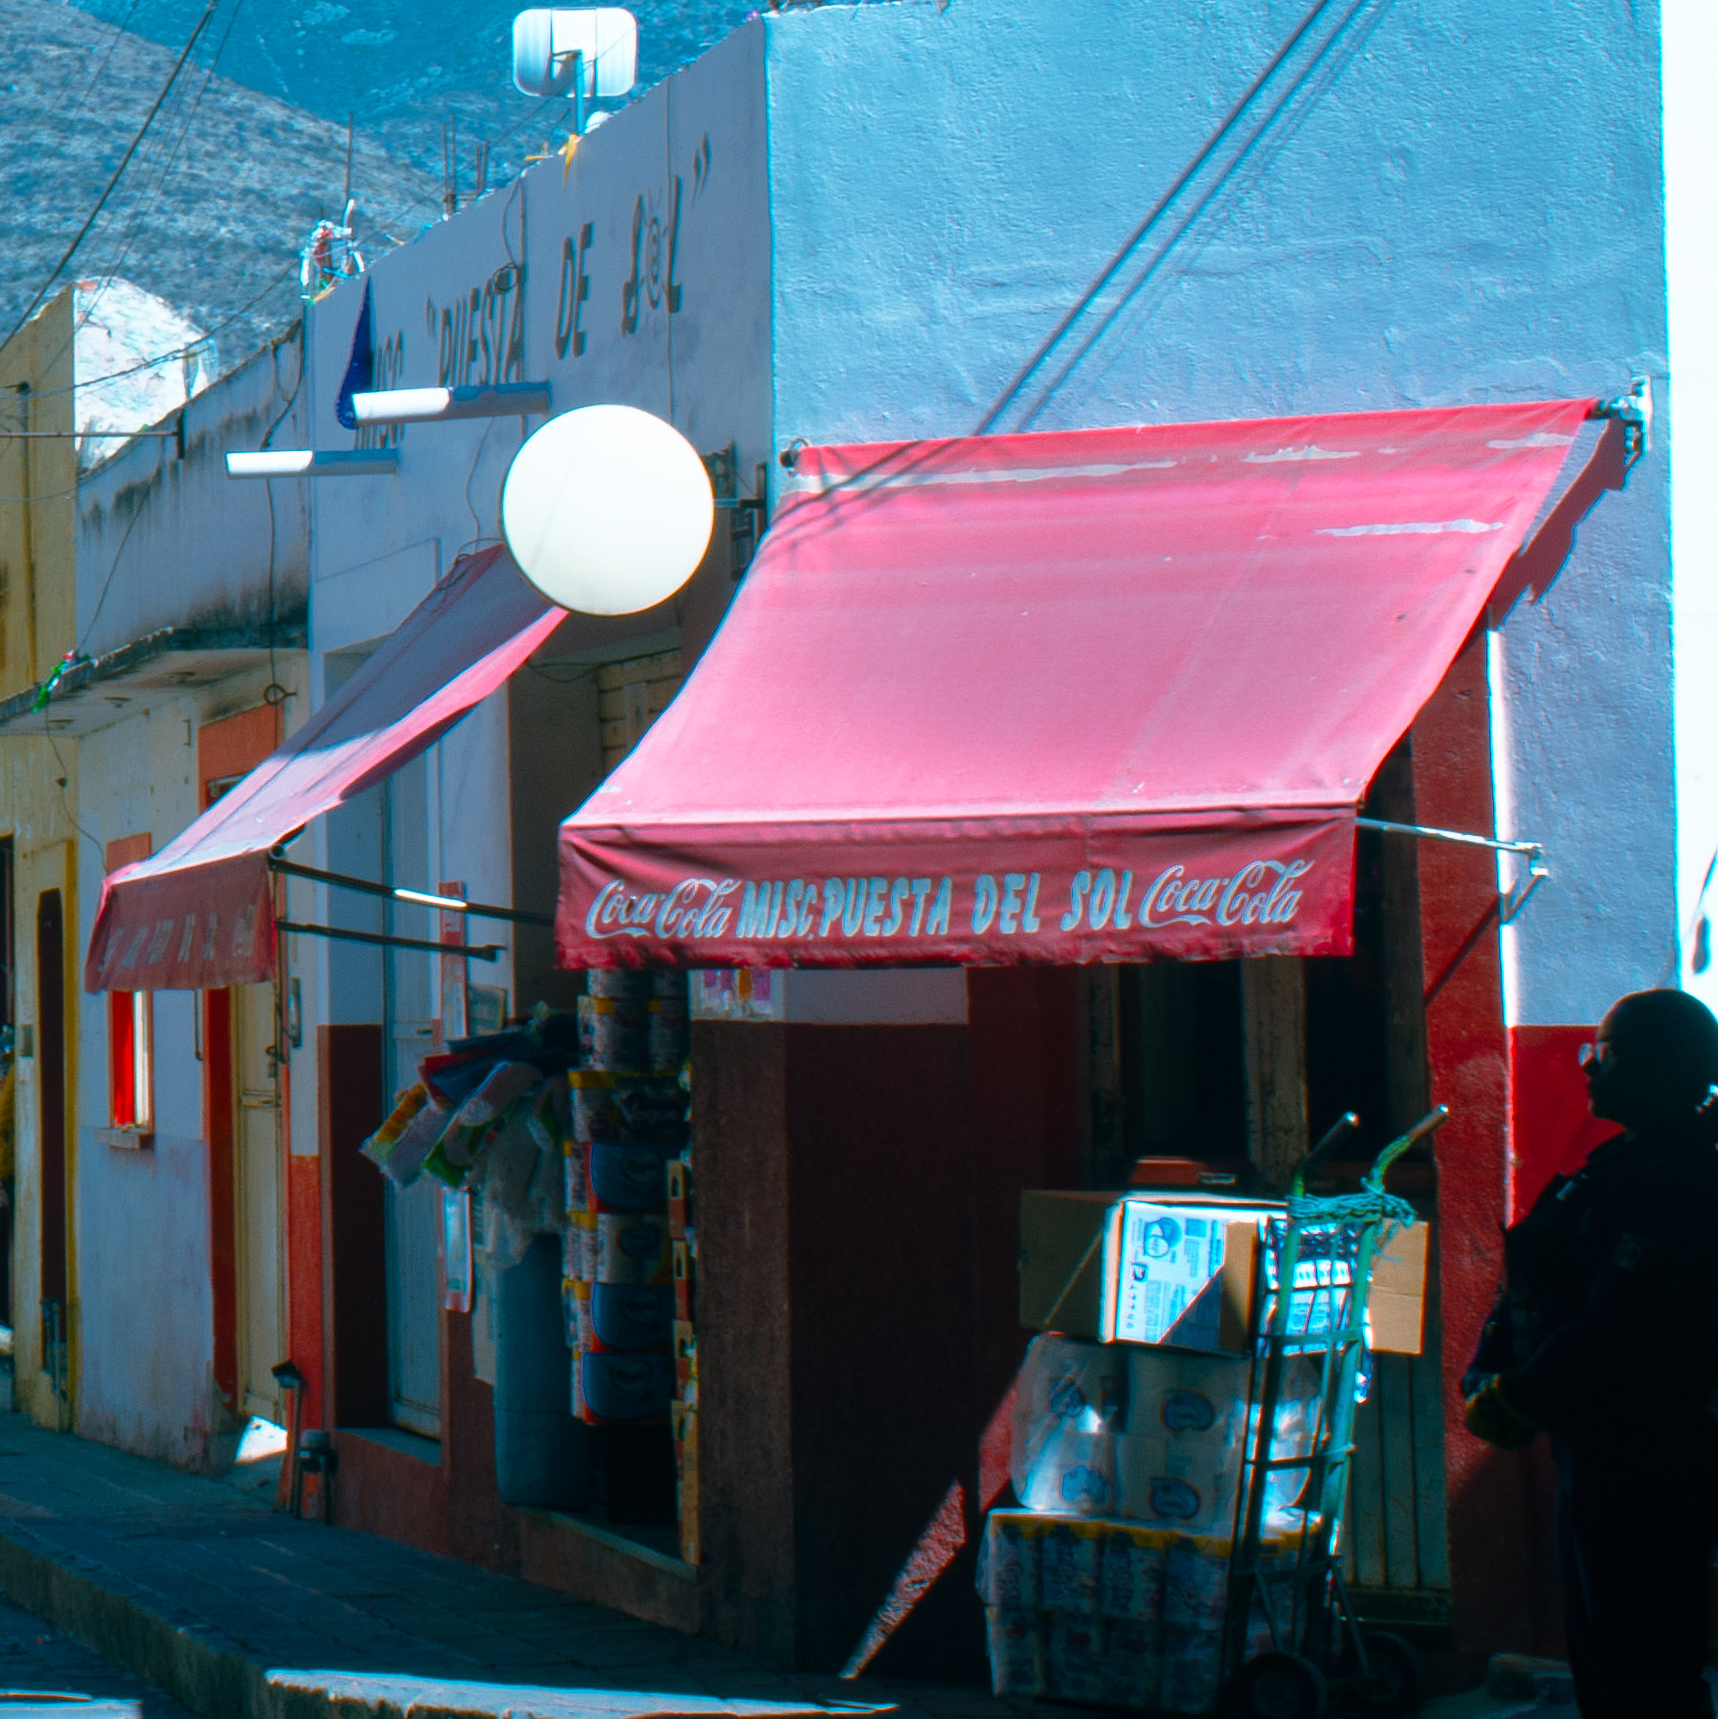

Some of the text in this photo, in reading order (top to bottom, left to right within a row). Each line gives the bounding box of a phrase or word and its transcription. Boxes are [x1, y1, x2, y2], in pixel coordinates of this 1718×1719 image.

[554, 220, 594, 359] DE
[818, 876, 952, 938] PUESTA
[971, 871, 1041, 935] DEL
[1060, 867, 1133, 931] SOL
